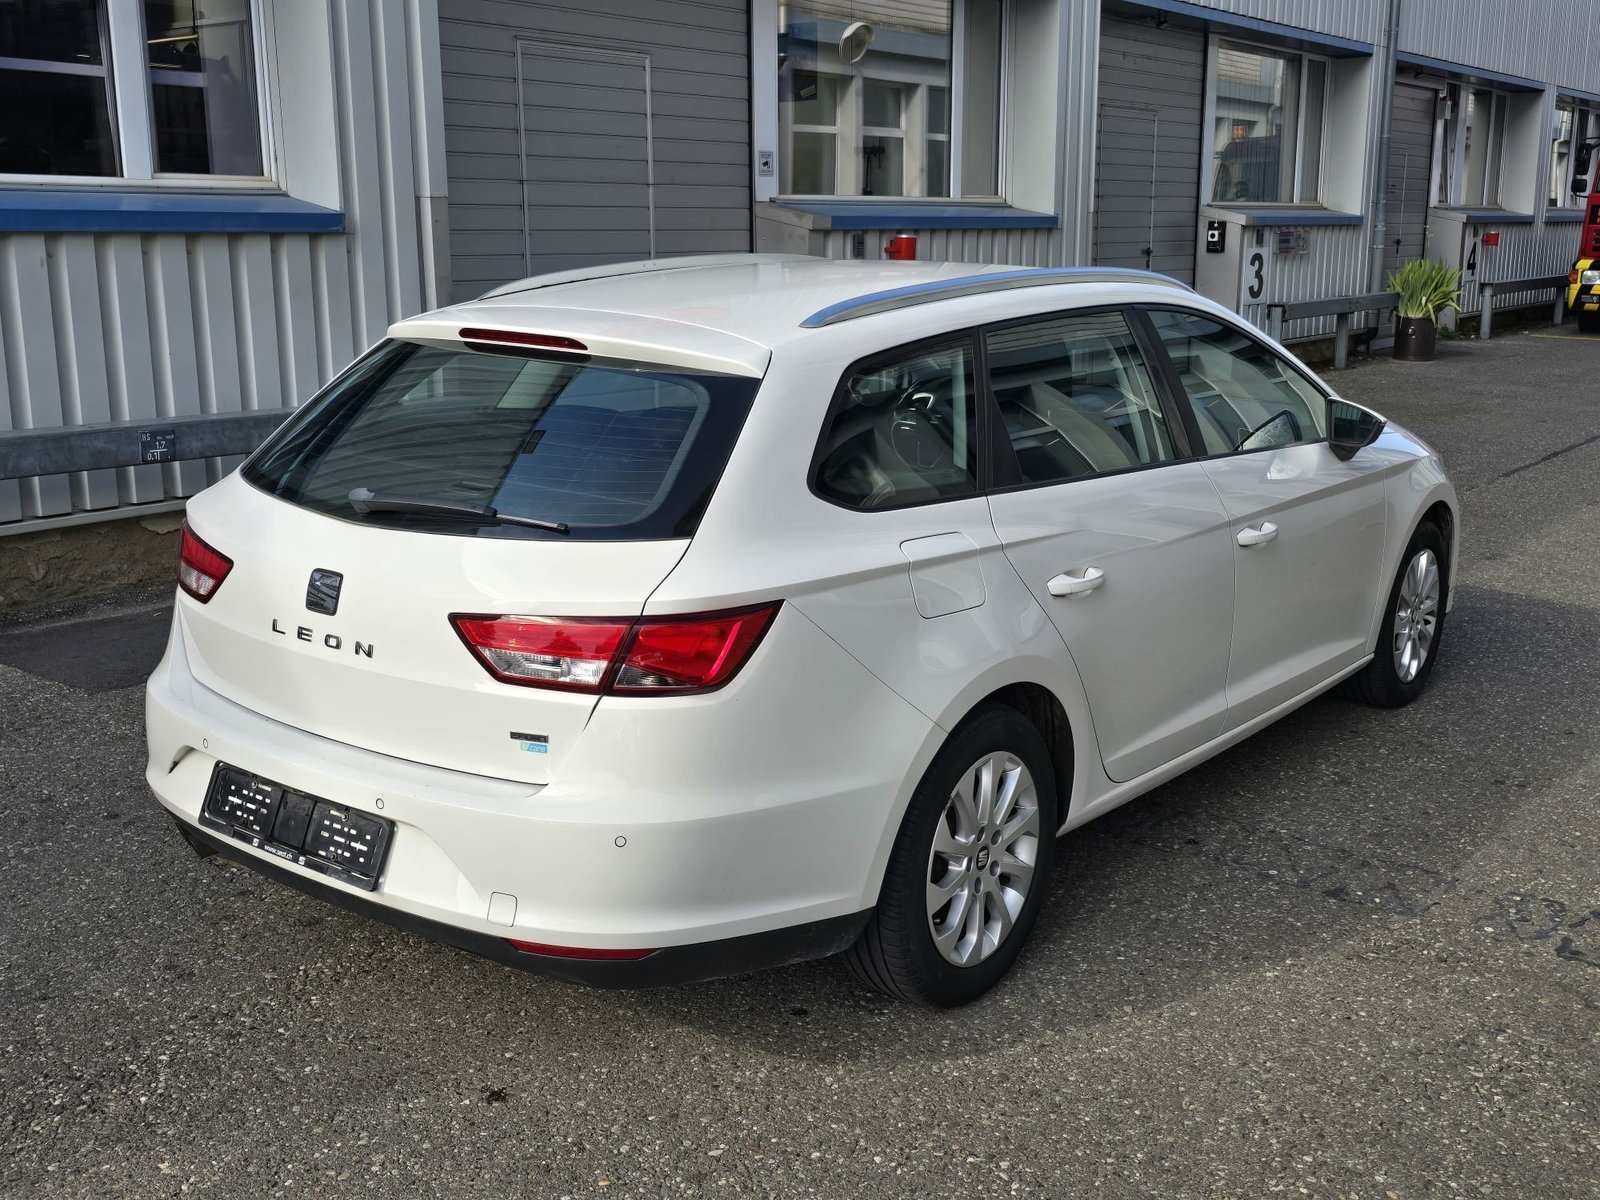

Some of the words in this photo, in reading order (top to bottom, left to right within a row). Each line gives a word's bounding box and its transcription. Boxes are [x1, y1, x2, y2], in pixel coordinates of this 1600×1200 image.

[1248, 252, 1264, 299] 3
[1466, 241, 1477, 276] 4
[272, 618, 374, 658] LEON
